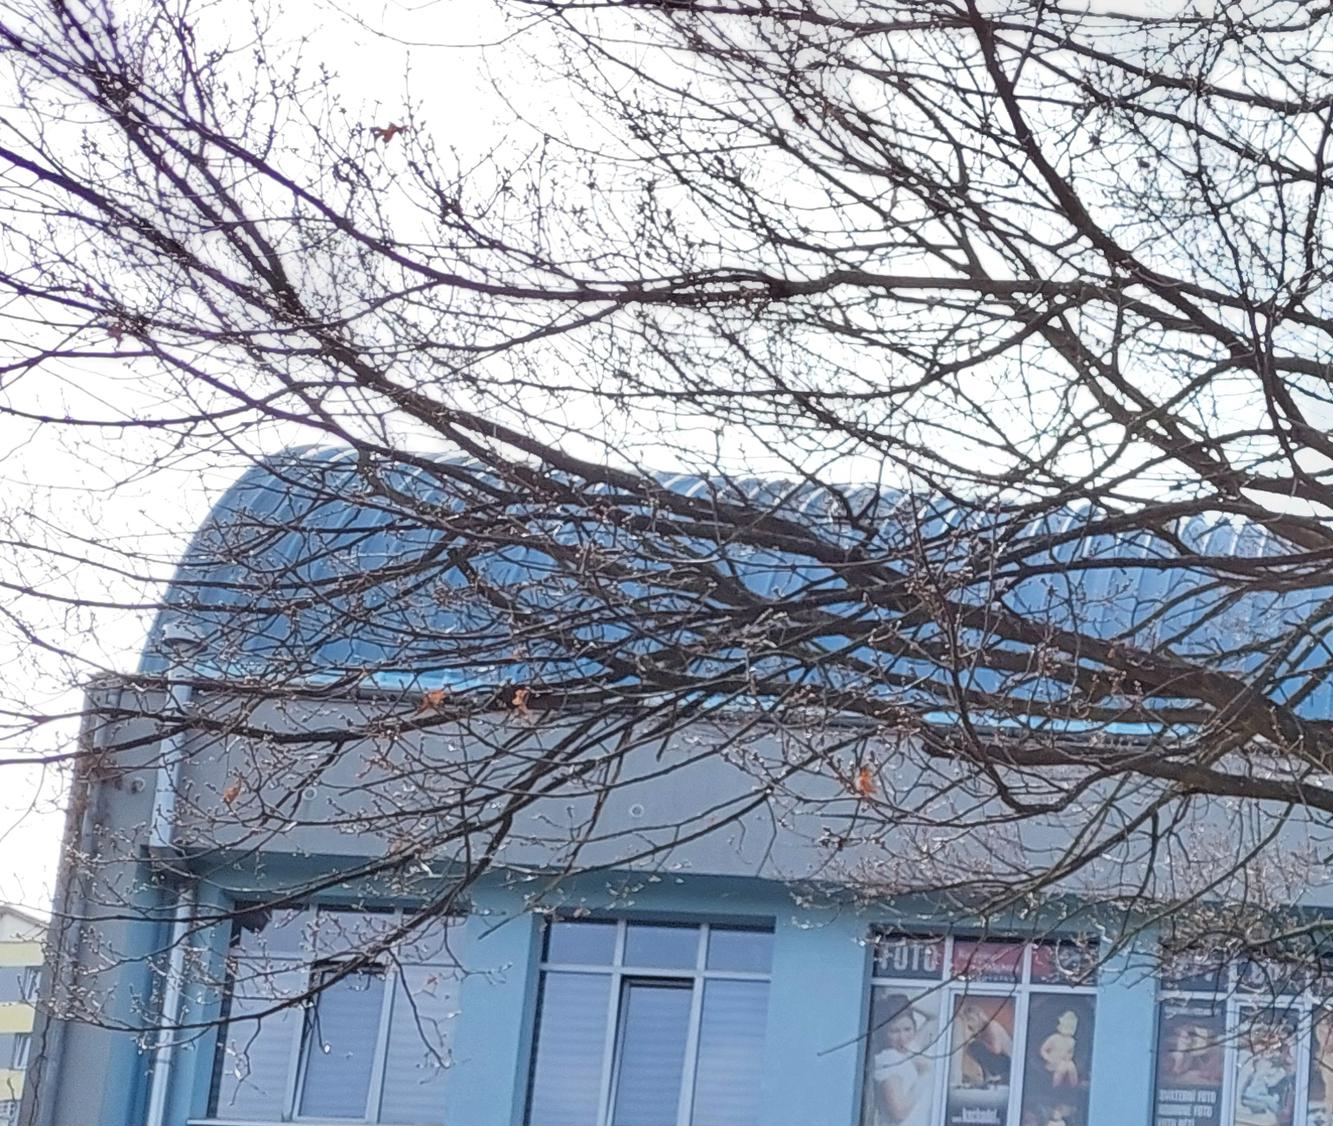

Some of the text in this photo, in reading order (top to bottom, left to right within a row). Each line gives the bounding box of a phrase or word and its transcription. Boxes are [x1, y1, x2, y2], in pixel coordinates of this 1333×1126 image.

[880, 943, 938, 972] FOTO
[1197, 1090, 1217, 1104] FOTO
[1194, 1105, 1213, 1118] FOTO
